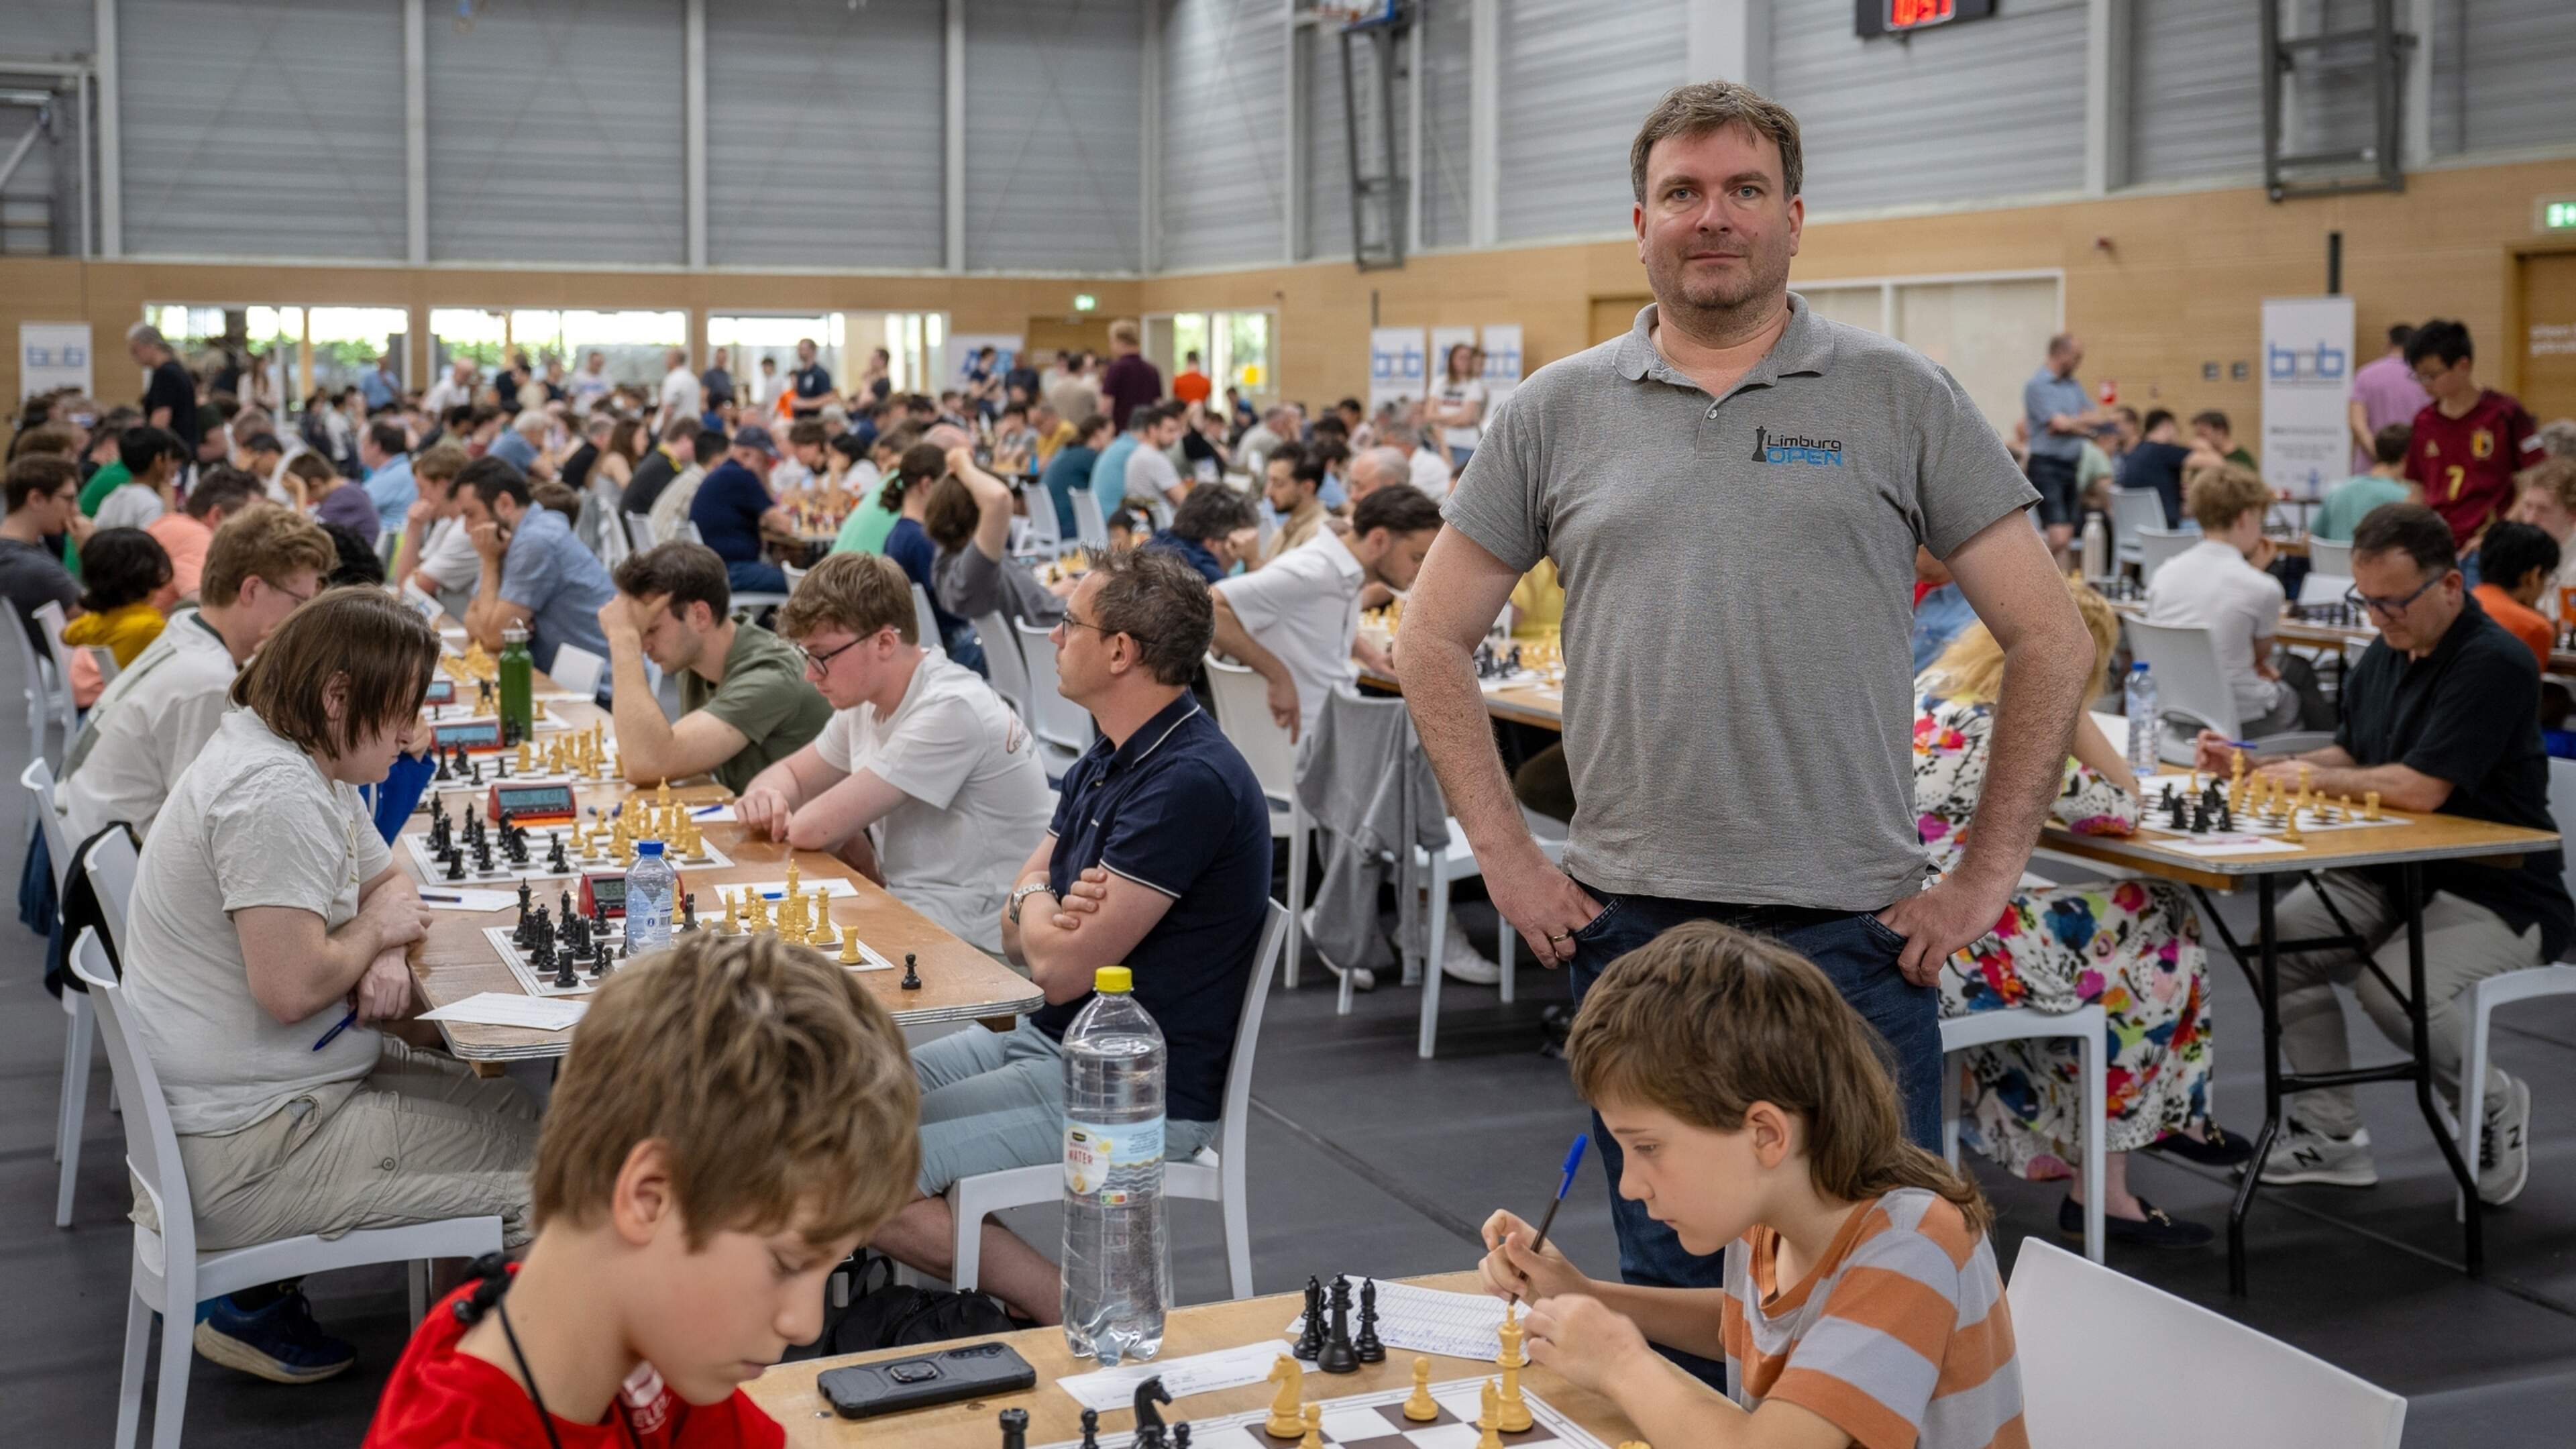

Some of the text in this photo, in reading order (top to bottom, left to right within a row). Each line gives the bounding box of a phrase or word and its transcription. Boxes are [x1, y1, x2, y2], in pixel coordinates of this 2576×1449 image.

[1767, 435, 1841, 451] Limburg
[1766, 447, 1844, 467] OPEN
[2446, 465, 2465, 500] 7
[2292, 1147, 2322, 1167] N
